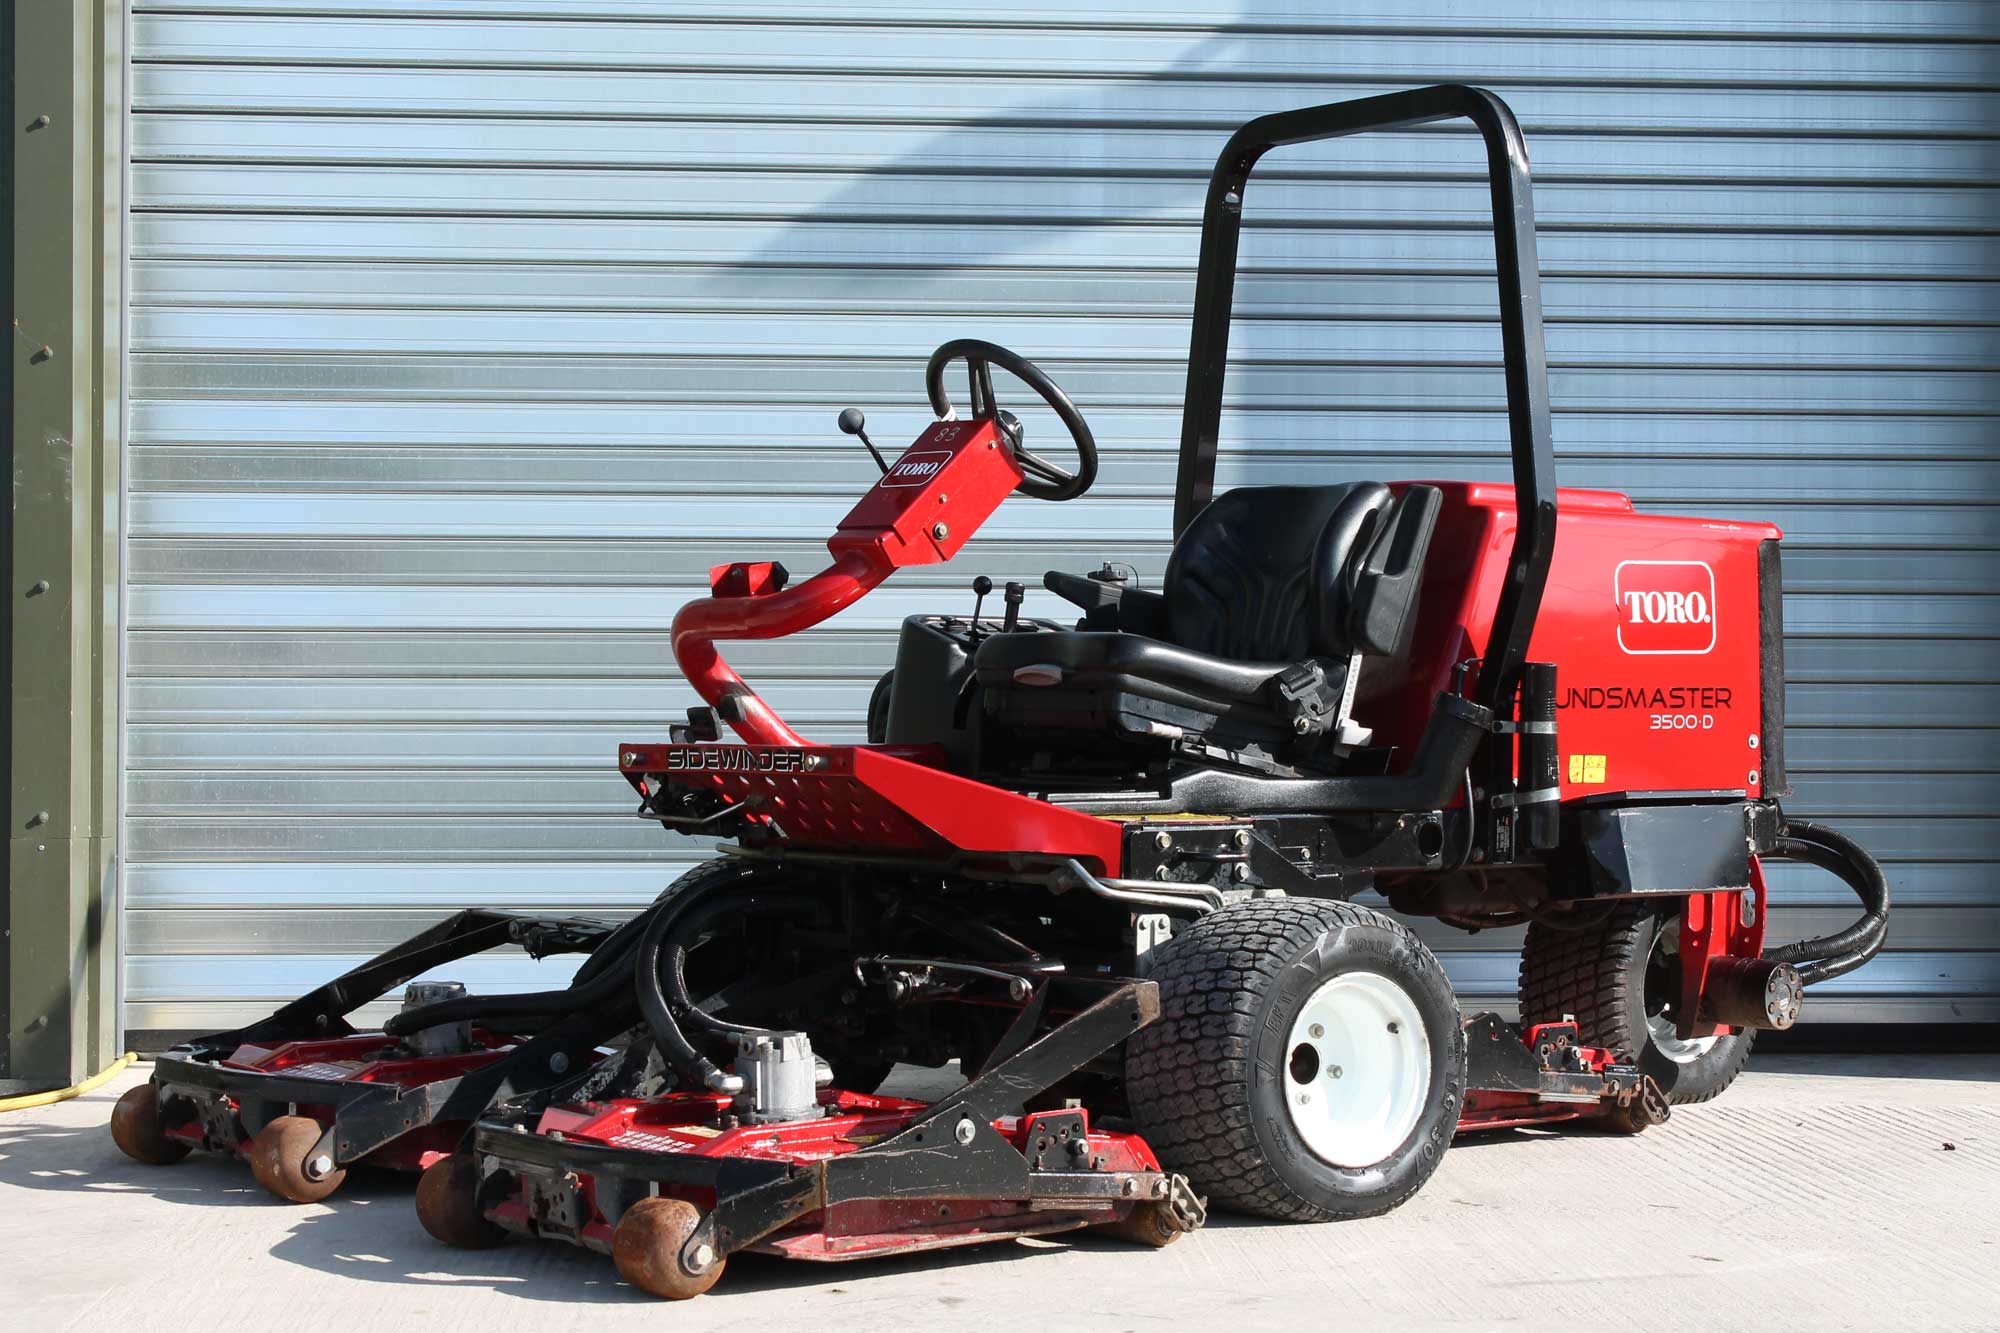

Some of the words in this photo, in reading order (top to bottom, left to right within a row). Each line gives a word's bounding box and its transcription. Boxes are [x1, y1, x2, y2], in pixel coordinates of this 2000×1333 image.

[934, 427, 960, 441] 83
[894, 462, 938, 476] TORO
[1624, 591, 1711, 623] TORO
[1556, 687, 1732, 709] UNDSMASTER
[668, 749, 805, 773] SIDEWINDER
